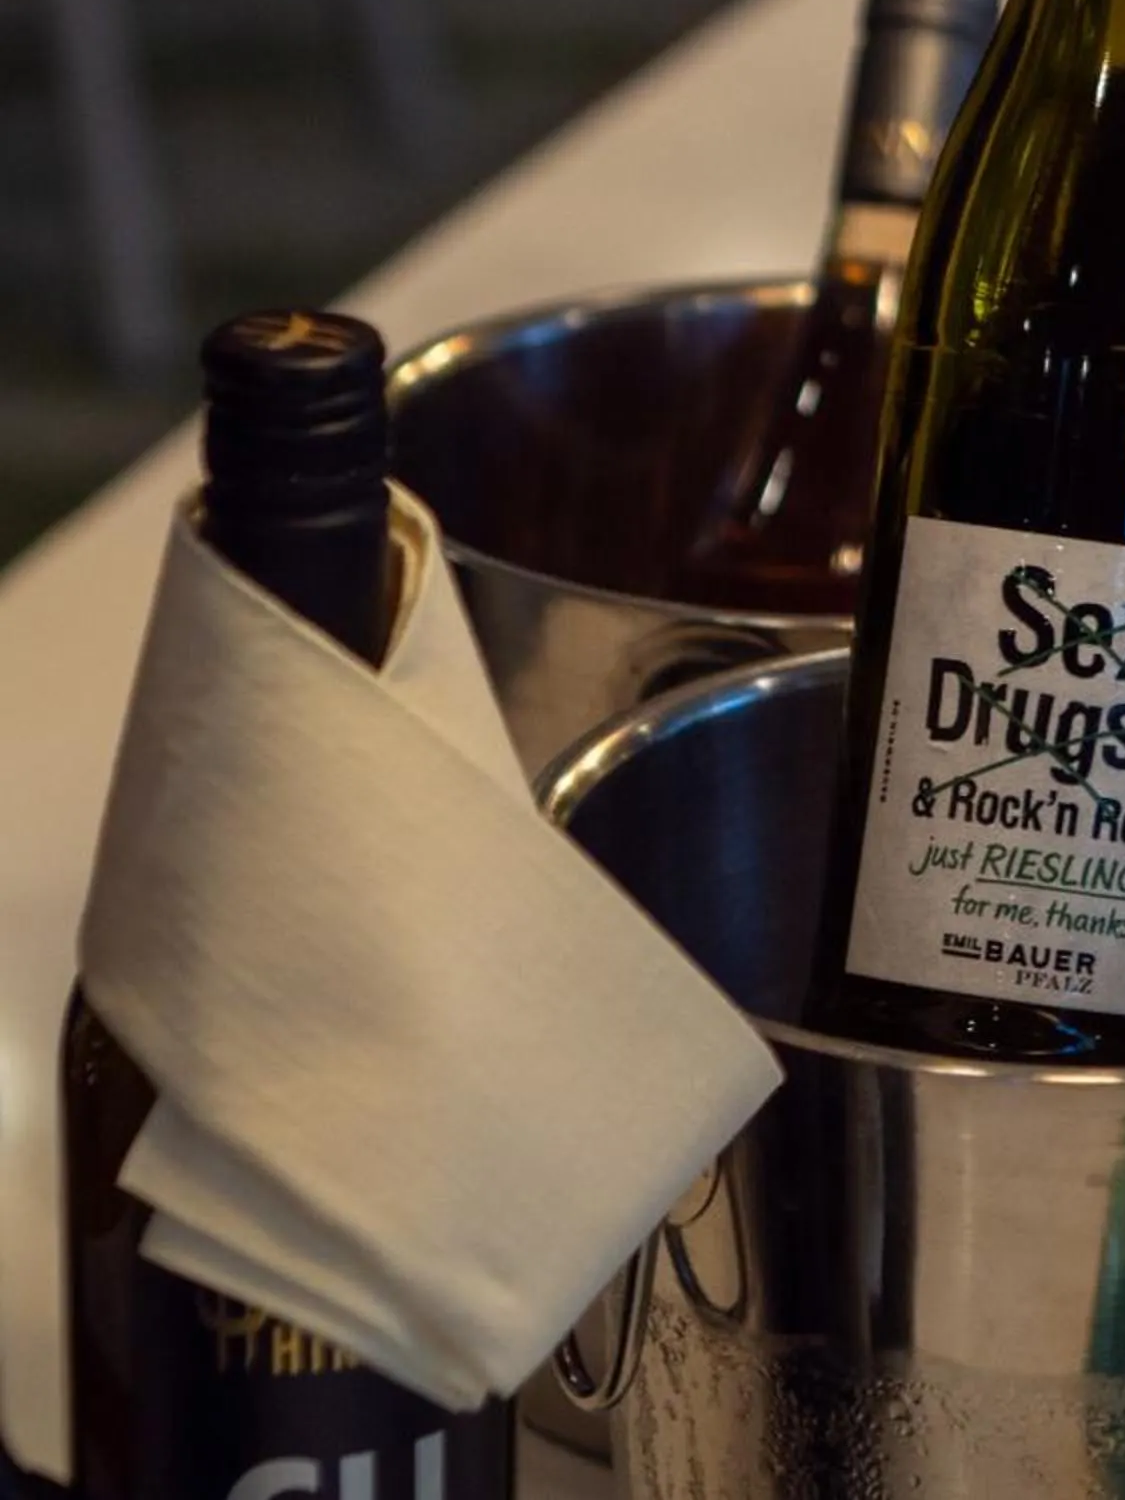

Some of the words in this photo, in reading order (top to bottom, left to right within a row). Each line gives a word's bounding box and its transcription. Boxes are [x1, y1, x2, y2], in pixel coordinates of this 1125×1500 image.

[911, 776, 935, 819] &
[947, 778, 1079, 838] Rock'n
[909, 835, 973, 876] just
[952, 885, 989, 918] for
[943, 933, 981, 951] EMIL
[985, 940, 1096, 975] BAUER
[1016, 970, 1094, 994] PFALZ
